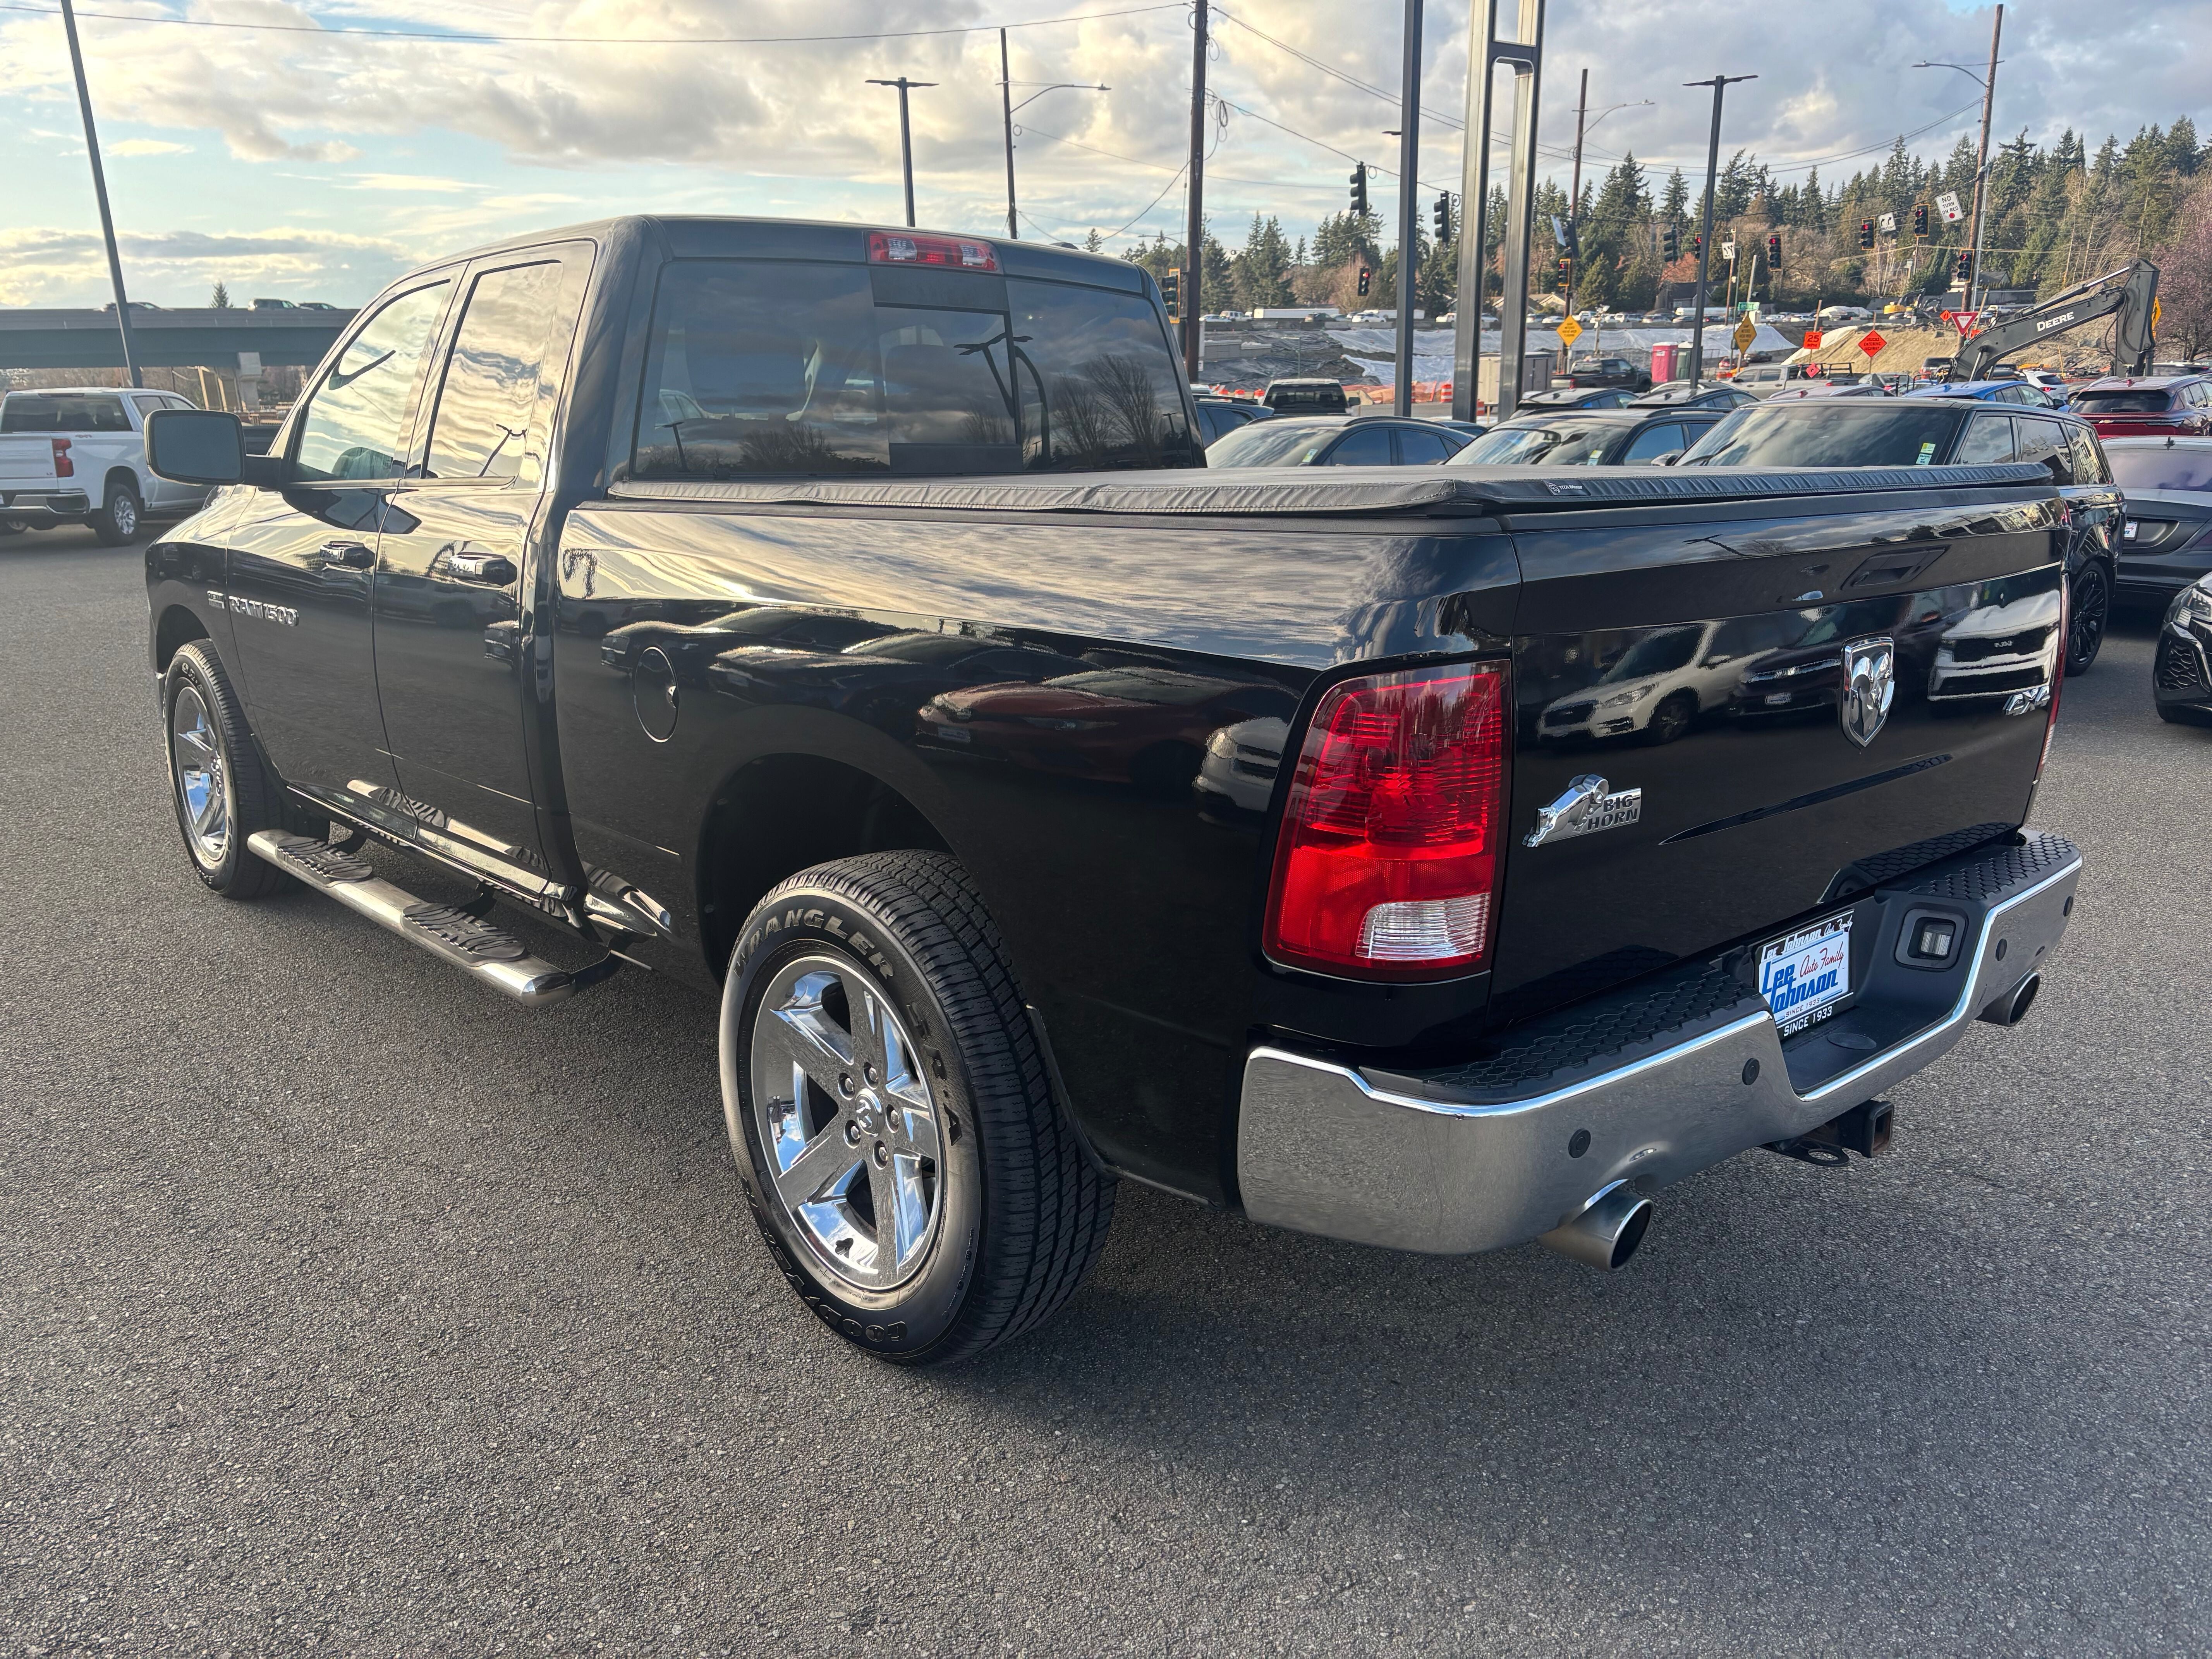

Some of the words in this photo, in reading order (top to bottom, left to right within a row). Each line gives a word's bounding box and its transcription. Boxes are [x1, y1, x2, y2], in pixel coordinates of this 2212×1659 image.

[2037, 311, 2075, 332] DEERE
[1603, 795, 1633, 813] BIG
[1587, 808, 1638, 831] HORN
[734, 909, 893, 980] WRANGLER
[1781, 929, 1822, 955] Johnson
[1800, 955, 1819, 977] Auto
[1820, 941, 1844, 970] Family
[1762, 961, 1796, 995] Lee
[1770, 969, 1838, 1013] Johnson
[1784, 1016, 1809, 1037] SINCE
[1813, 1006, 1832, 1024] 1933
[1786, 1005, 1804, 1018] SINCE
[1806, 998, 1820, 1009] 1933
